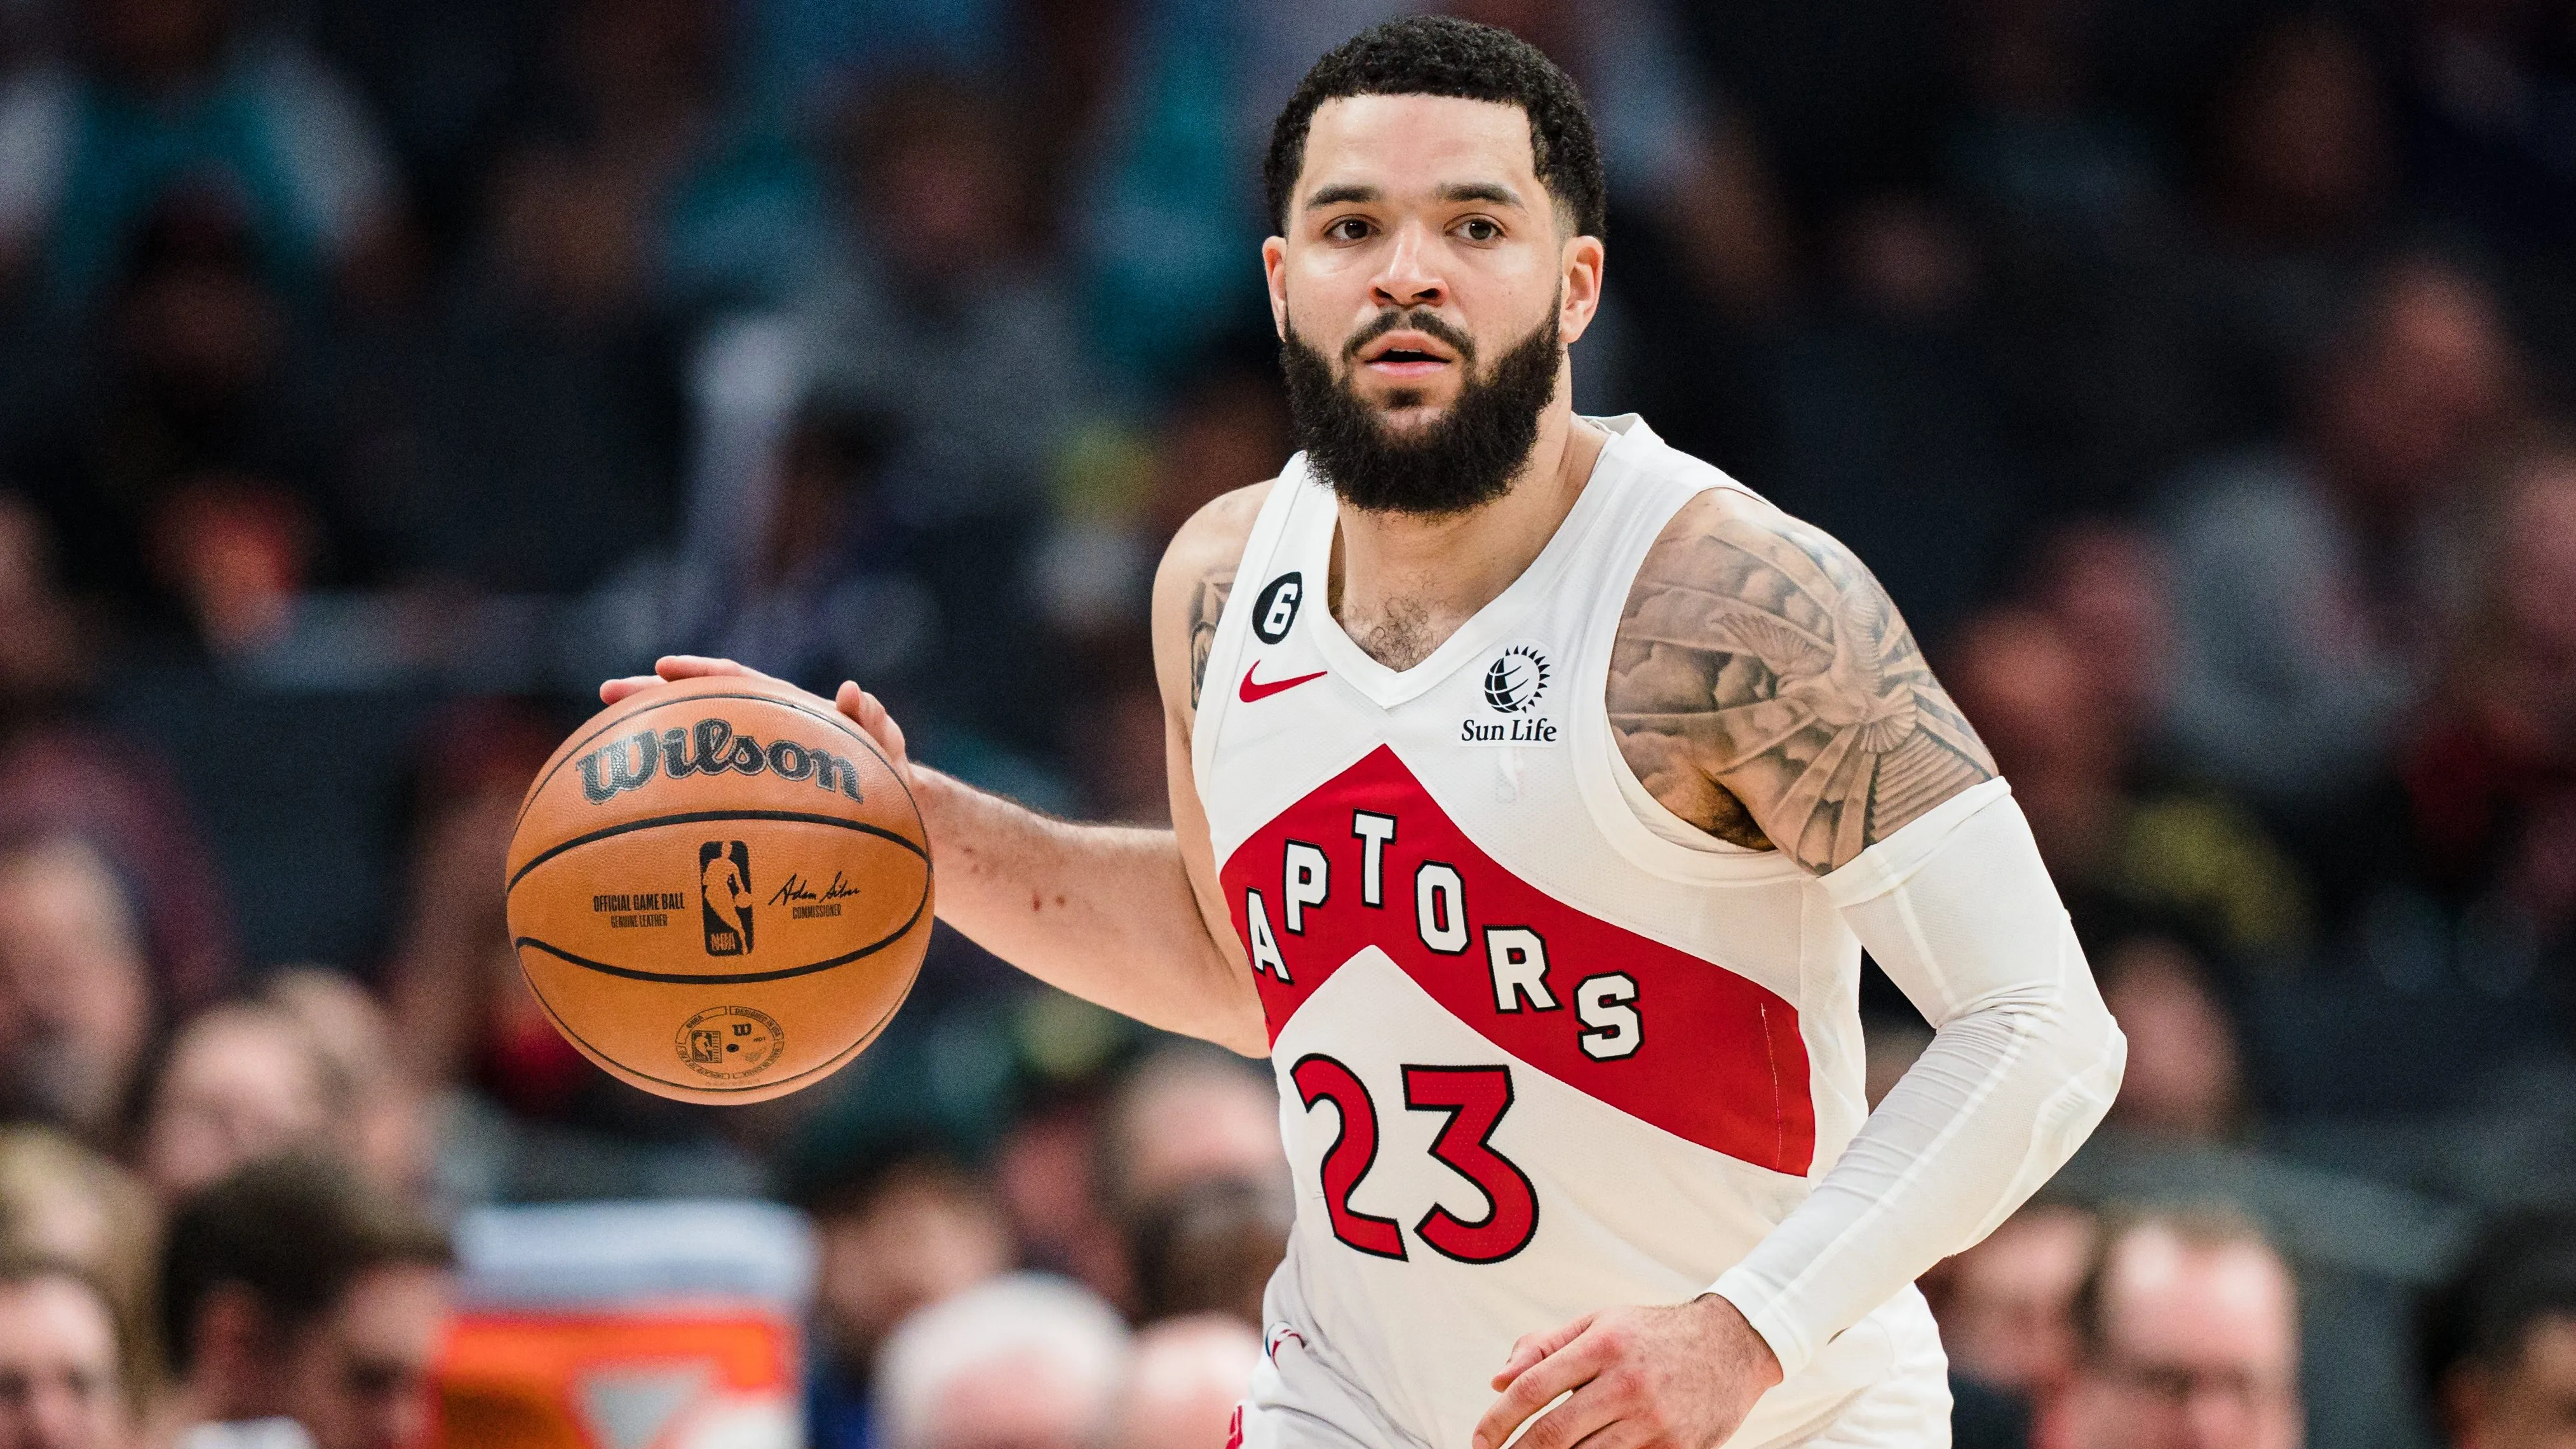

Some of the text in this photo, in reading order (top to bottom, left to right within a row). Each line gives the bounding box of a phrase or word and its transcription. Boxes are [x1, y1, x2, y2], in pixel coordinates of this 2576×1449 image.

[1263, 583, 1298, 635] 6
[1461, 717, 1557, 743] Sun Life
[576, 718, 863, 805] Wilson
[593, 892, 685, 912] OFFICIAL GAME BALL
[792, 903, 842, 920] COMMISSIONER
[610, 913, 668, 929] GENUINE LEATHER
[710, 931, 736, 952] NBA
[1289, 1051, 1540, 1266] 23
